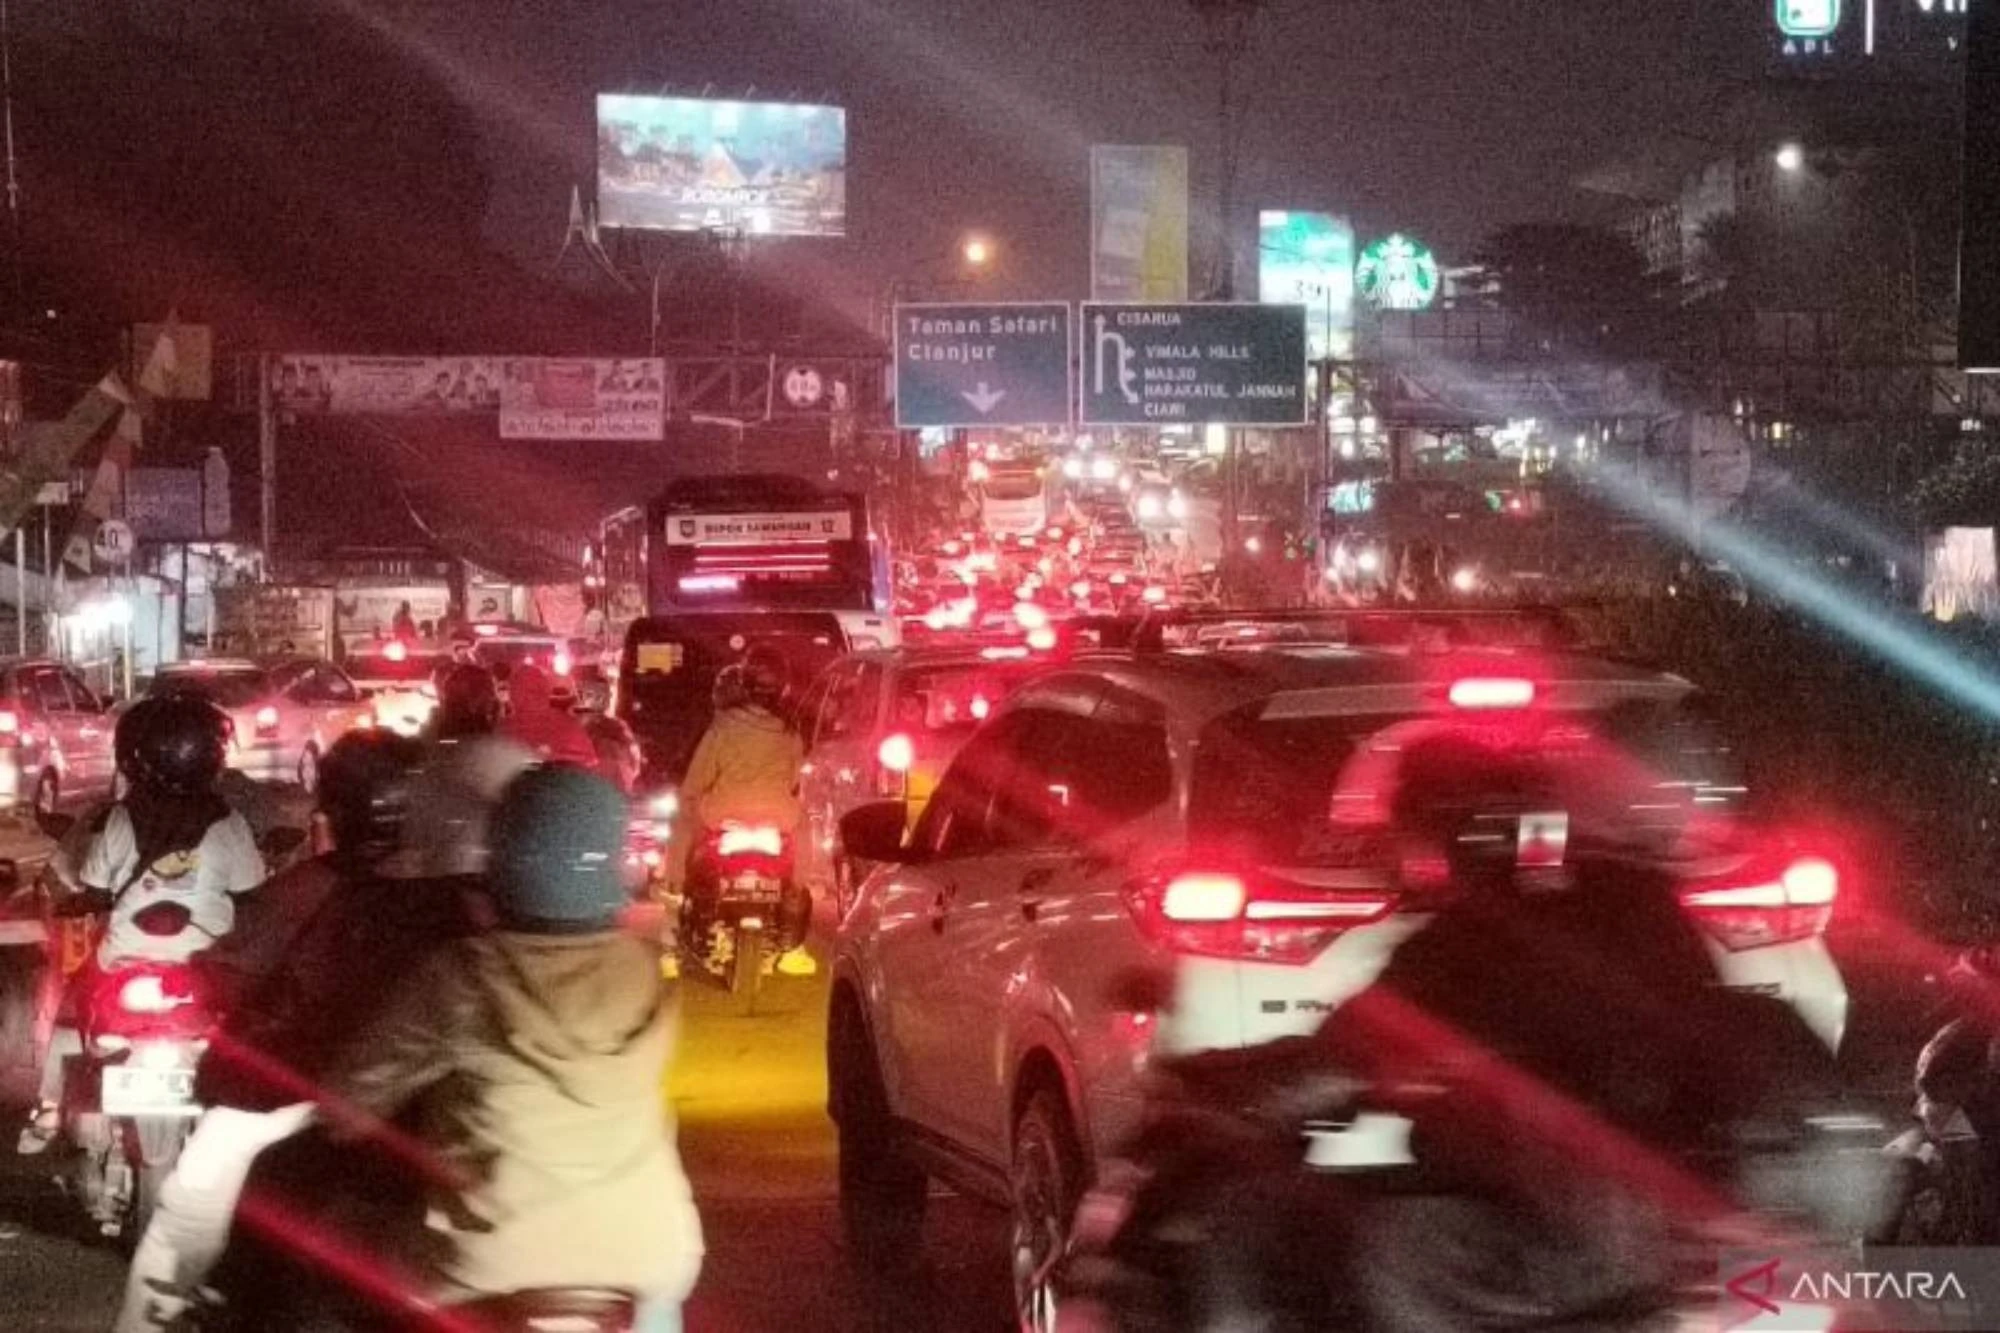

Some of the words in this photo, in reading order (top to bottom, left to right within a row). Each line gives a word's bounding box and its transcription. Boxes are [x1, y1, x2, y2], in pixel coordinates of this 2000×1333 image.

[908, 317, 981, 335] Taman
[989, 315, 1057, 335] Safari
[1116, 311, 1181, 326] CISARUA
[908, 343, 997, 365] Cianjur
[1145, 344, 1201, 359] VIMALA
[1143, 402, 1186, 417] CIAWI
